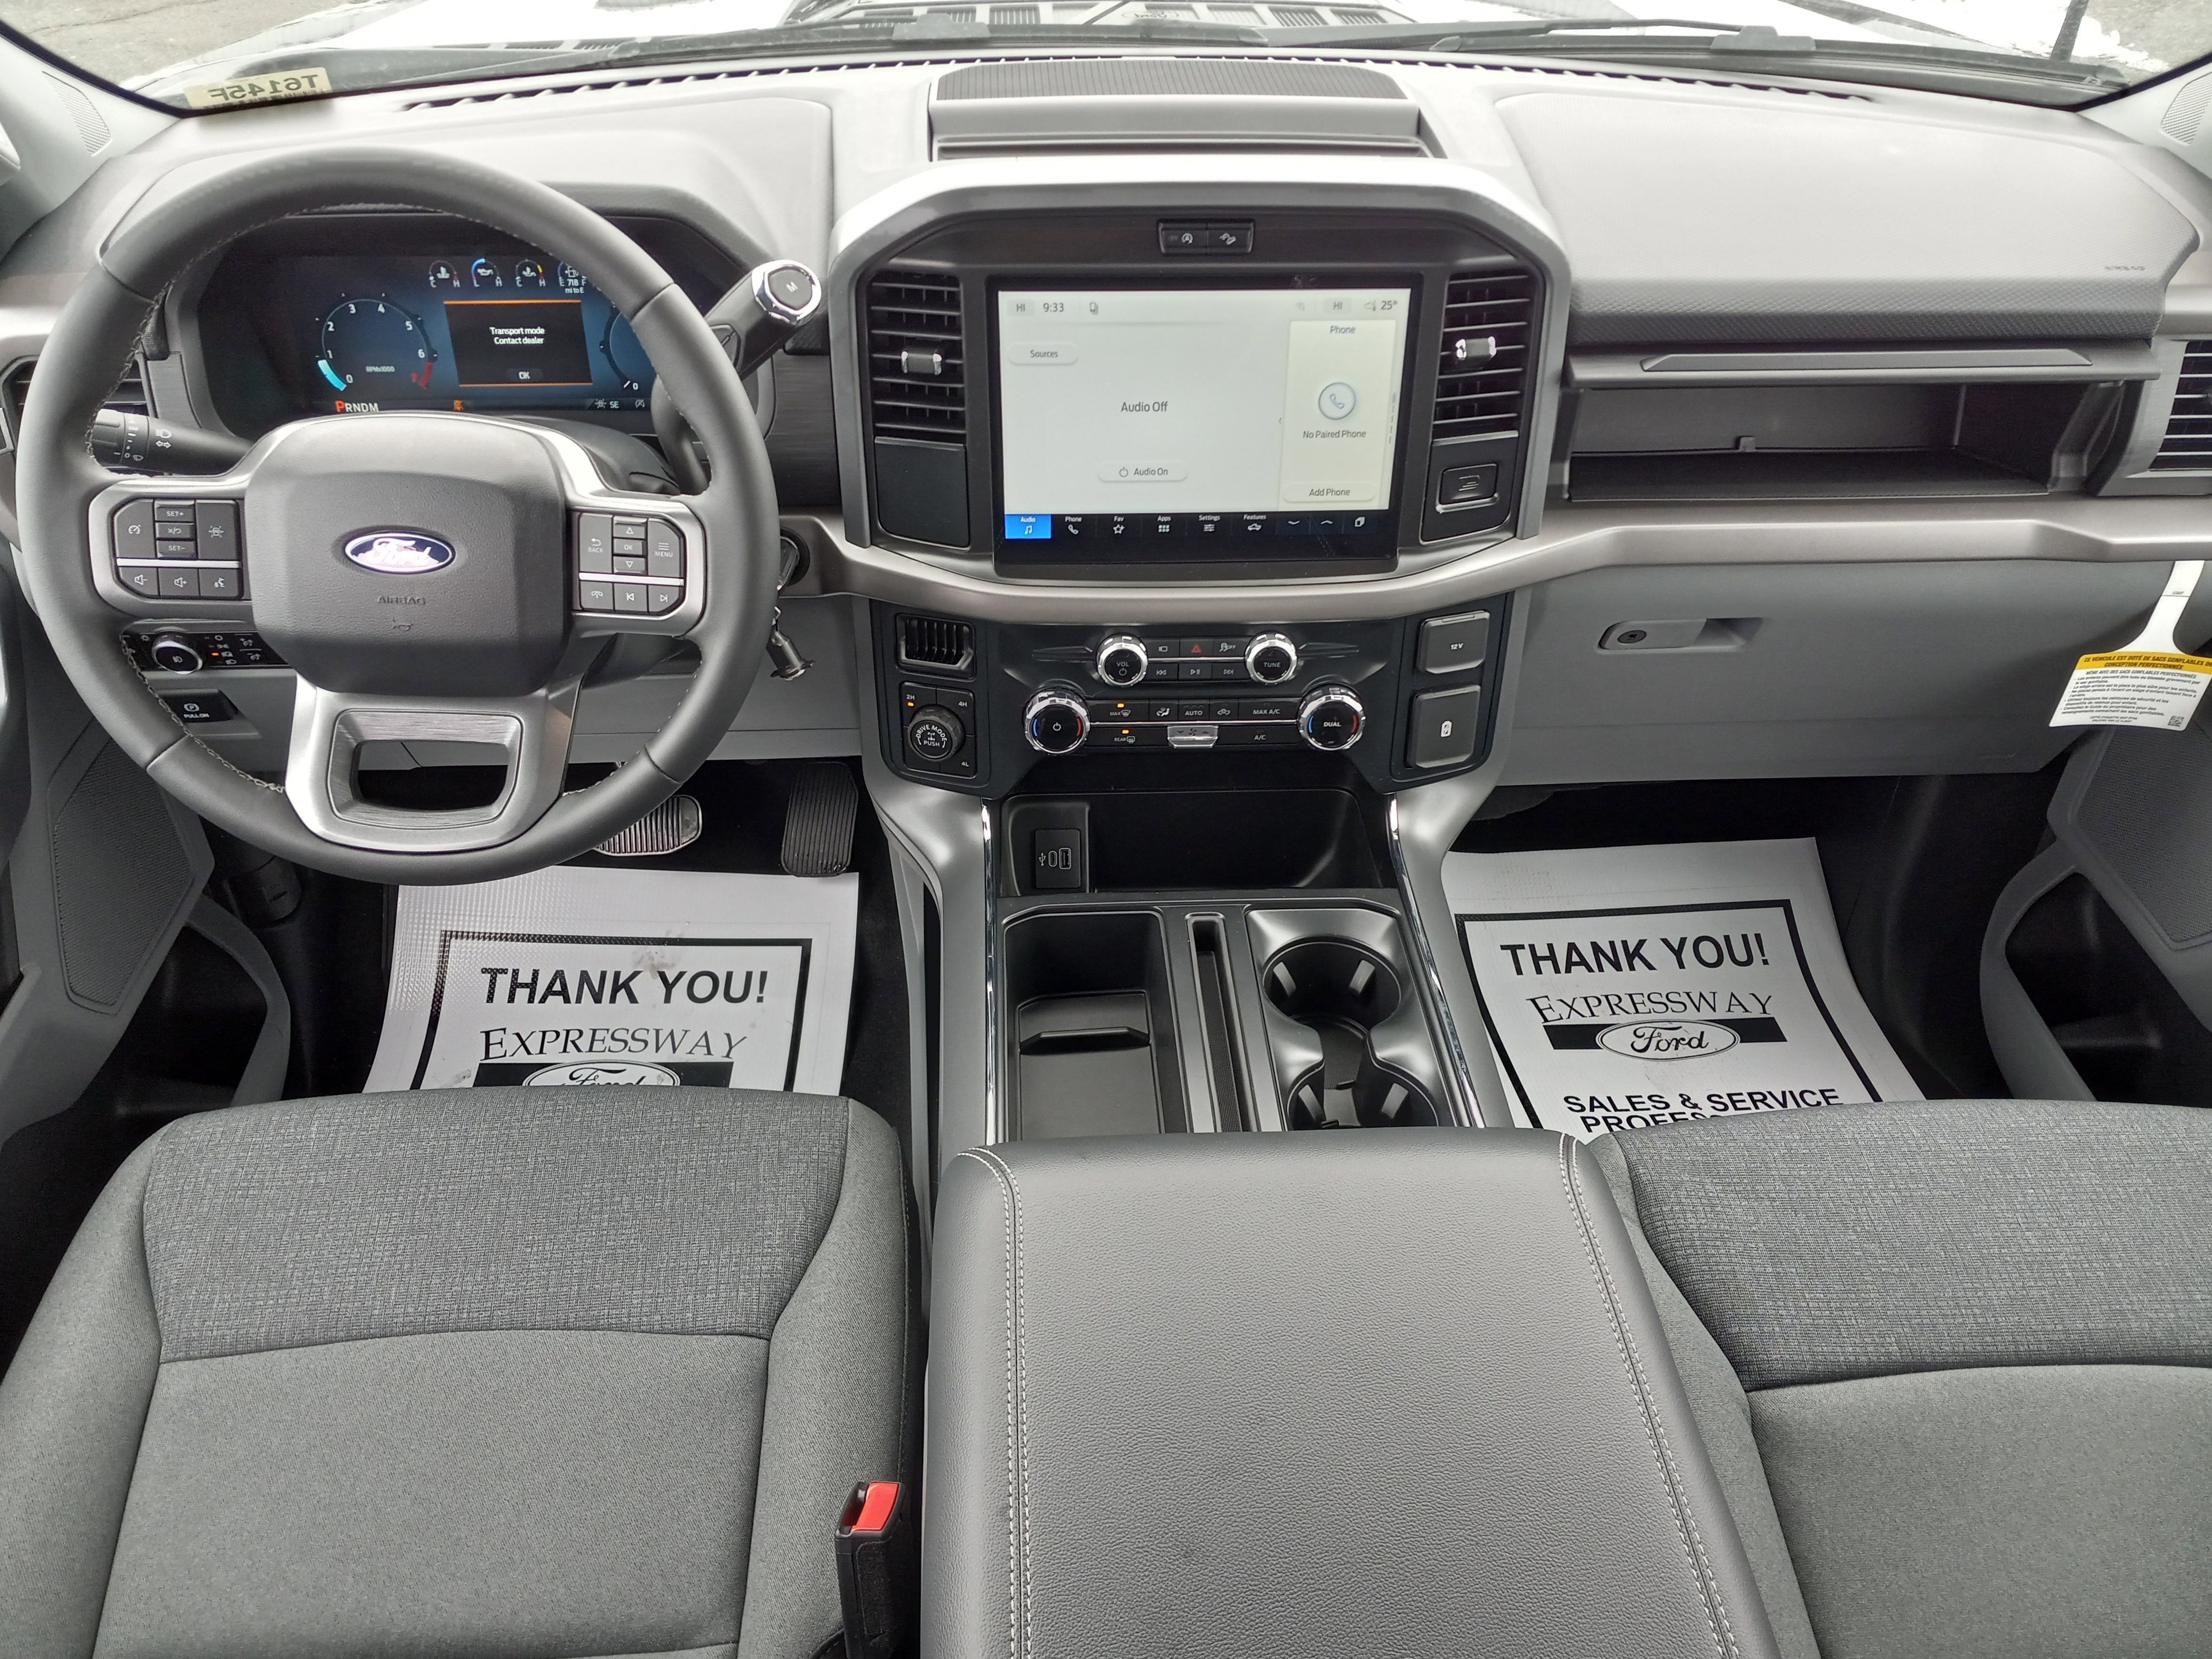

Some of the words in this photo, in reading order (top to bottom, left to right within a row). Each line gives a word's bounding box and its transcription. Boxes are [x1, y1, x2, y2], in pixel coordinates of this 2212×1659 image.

[349, 304, 356, 314] 3
[378, 303, 385, 313] 4
[1043, 302, 1064, 313] 9:33
[1381, 300, 1398, 310] 25°
[327, 321, 335, 331] 2
[405, 321, 413, 331] 5
[489, 326, 524, 336] Transport
[1330, 325, 1356, 334] Phone
[327, 349, 333, 359] 1
[418, 349, 425, 359] 6
[1030, 349, 1058, 358] Sources
[346, 374, 354, 384] 0
[518, 371, 530, 379] OK
[1121, 402, 1150, 412] Audio
[1152, 401, 1168, 412] Off
[1303, 430, 1314, 439] No
[1315, 430, 1340, 438] Paired
[1341, 430, 1366, 438] Phone
[1134, 467, 1156, 476] Audio
[1157, 467, 1168, 476] On
[1309, 488, 1324, 497] Add
[1325, 488, 1350, 496] Phone
[915, 724, 930, 738] DRIVE
[931, 725, 948, 742] MODE
[1500, 938, 1657, 976] THANK
[1659, 933, 1769, 970] YOU!
[481, 967, 644, 1004] THANK
[656, 970, 768, 1004] YOU!
[1526, 991, 1773, 1024] EXPRESSWAY
[480, 1027, 747, 1061] EXPRESSWAY
[1631, 1025, 1709, 1054] Ford
[1563, 1093, 1671, 1114] SALES
[1678, 1093, 1702, 1109] &
[1707, 1088, 1844, 1111] SERVICE
